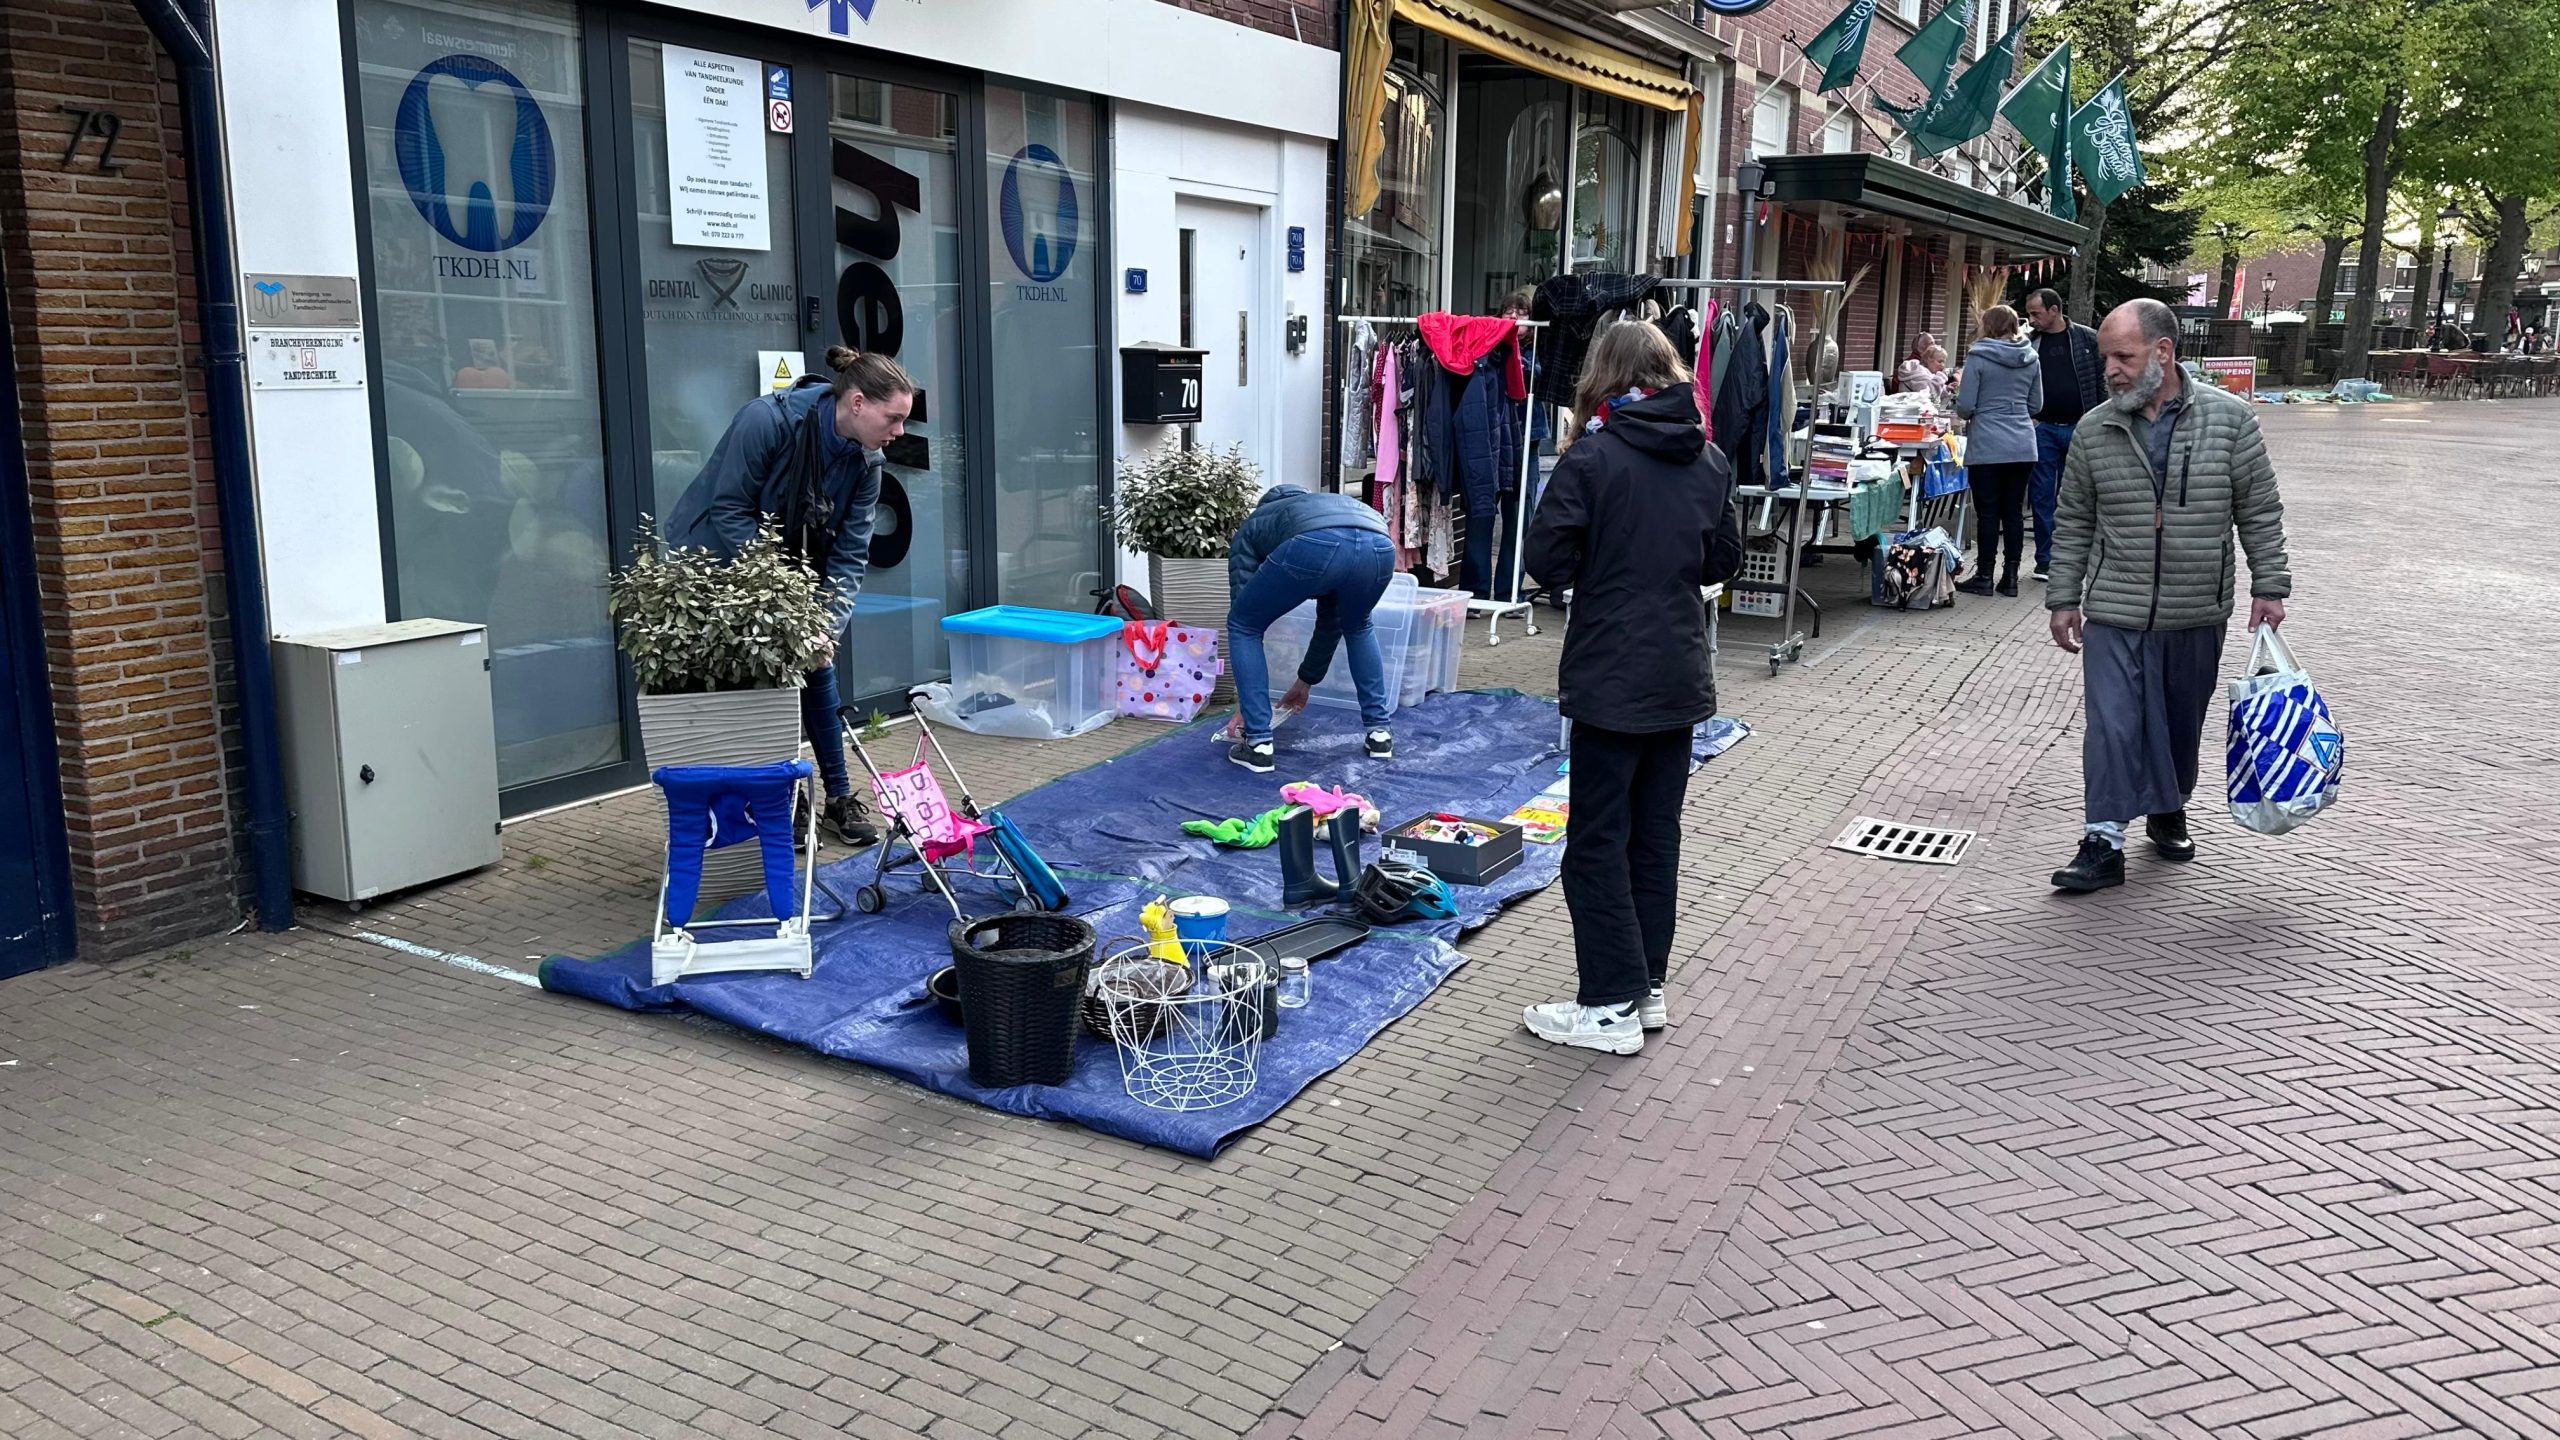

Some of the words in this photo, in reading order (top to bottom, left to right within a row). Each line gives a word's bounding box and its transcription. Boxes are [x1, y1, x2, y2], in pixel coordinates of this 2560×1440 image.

[694, 60, 706, 68] ALLE
[708, 63, 734, 72] ASPECTEN
[685, 70, 697, 78] VAN
[699, 73, 744, 86] TANDHEELKUNDE
[705, 86, 725, 94] ONDER
[714, 99, 728, 107] DAK!
[57, 104, 122, 172] 72
[686, 208, 702, 216] Schrijf
[433, 256, 537, 279] TKDH.NL
[1133, 275, 1142, 286] 70
[649, 280, 700, 299] DENTAL
[751, 283, 793, 301] CLINIC
[1016, 286, 1067, 302] TKDH.NL
[644, 311, 674, 320] DUTCH
[270, 338, 344, 348] BRANCHEVERENIGING
[283, 370, 338, 380] TANDTECHNIEK
[1181, 378, 1199, 408] 70
